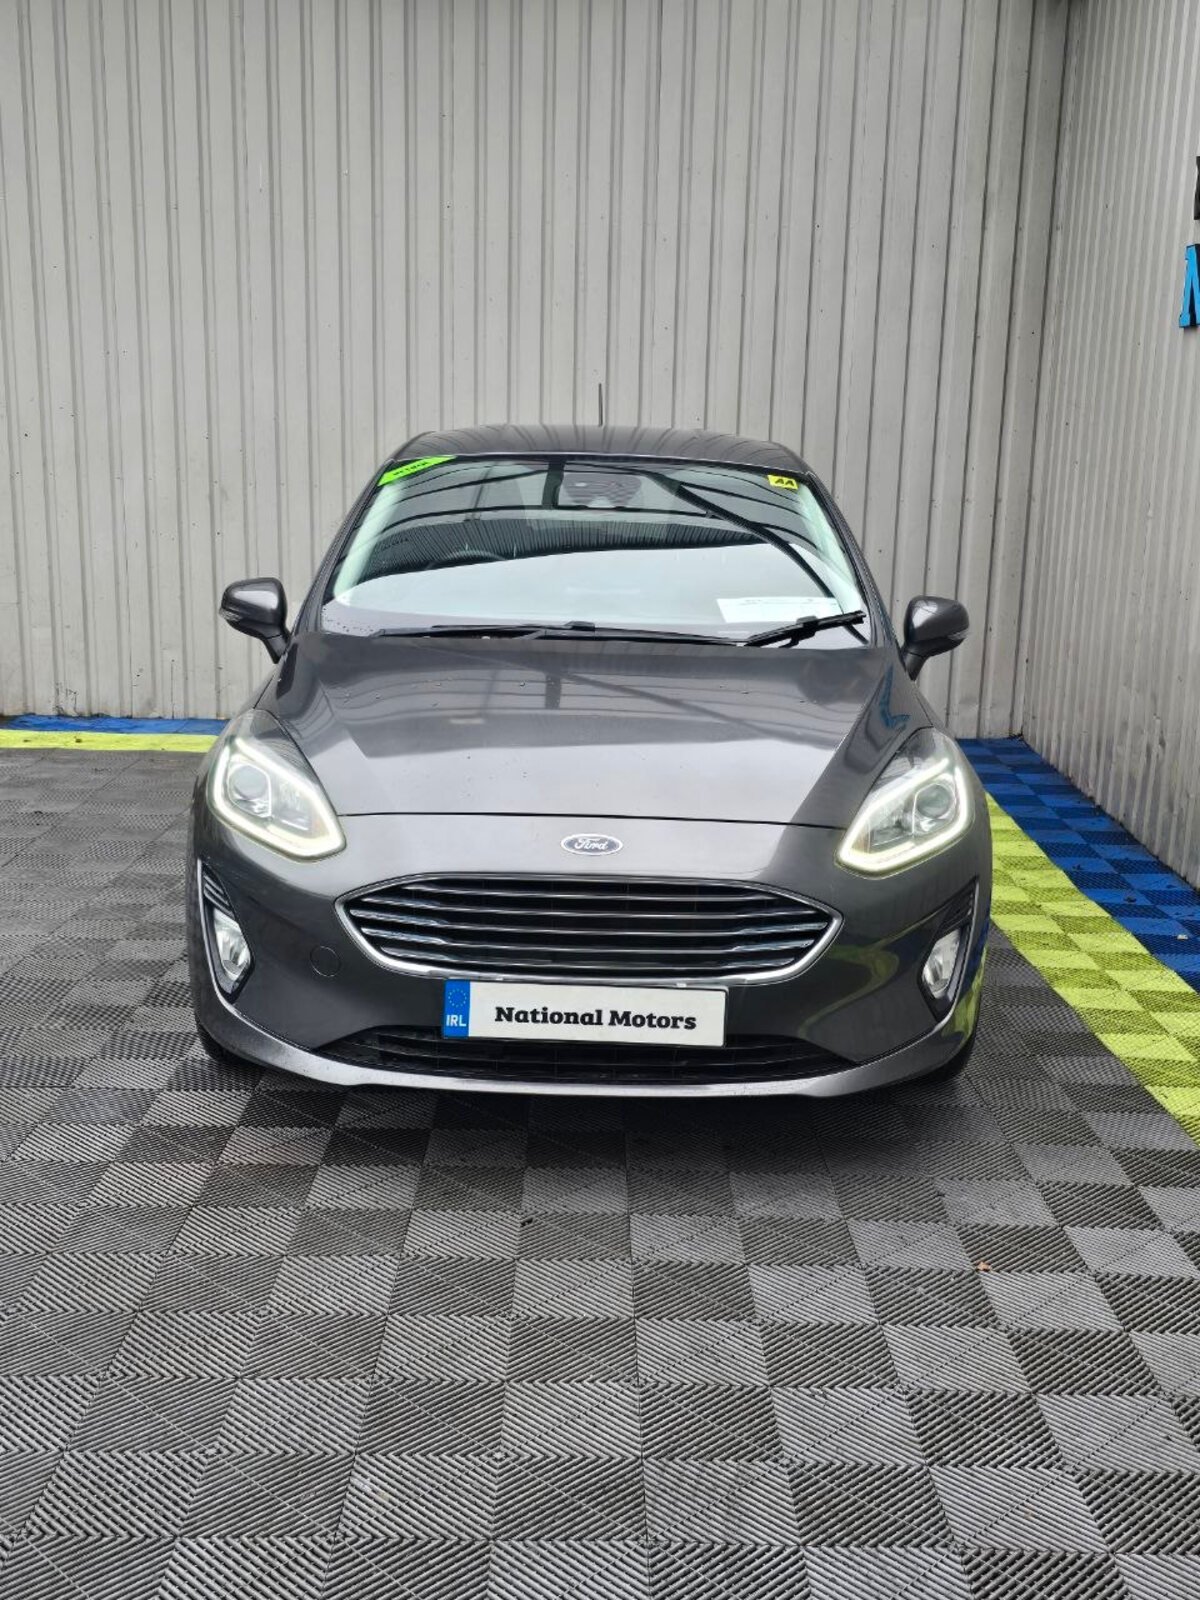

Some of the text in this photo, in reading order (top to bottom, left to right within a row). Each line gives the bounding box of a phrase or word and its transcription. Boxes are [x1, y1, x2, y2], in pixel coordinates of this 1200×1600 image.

[774, 478, 795, 486] AA
[574, 837, 609, 850] Ford
[446, 1014, 467, 1027] IRL
[494, 1006, 697, 1030] National Motors
